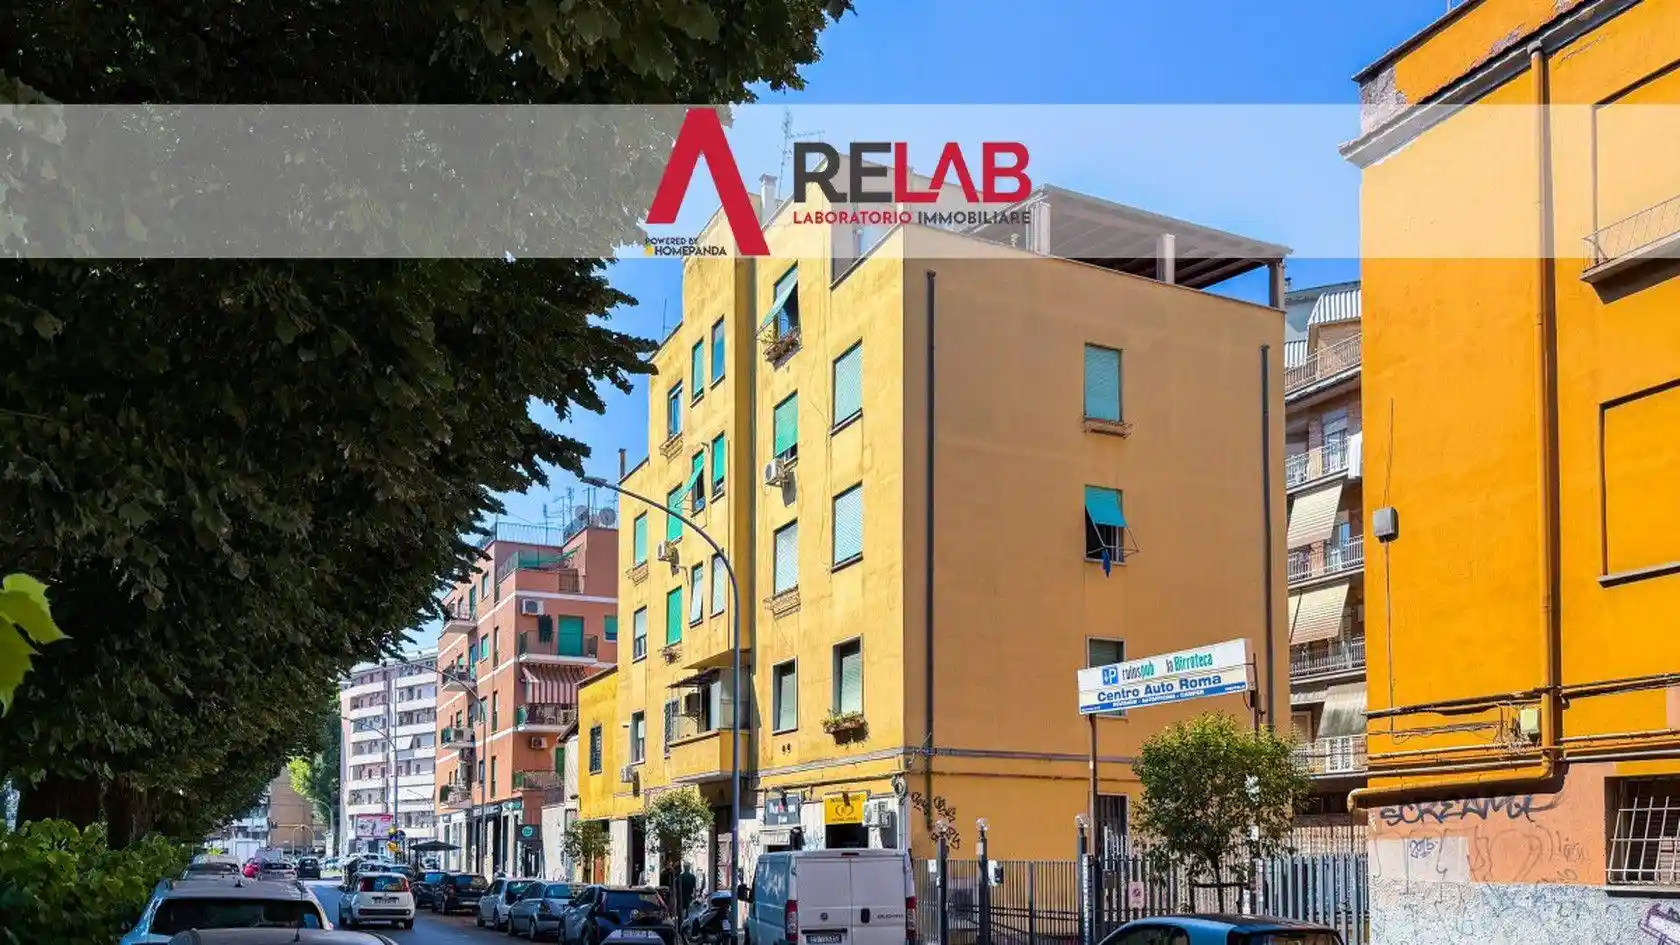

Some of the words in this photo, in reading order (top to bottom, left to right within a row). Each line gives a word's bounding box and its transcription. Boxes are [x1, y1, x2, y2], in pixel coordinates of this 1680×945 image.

[1097, 686, 1140, 702] Centro
[1144, 682, 1174, 698] Auto
[1179, 674, 1222, 690] Roma
